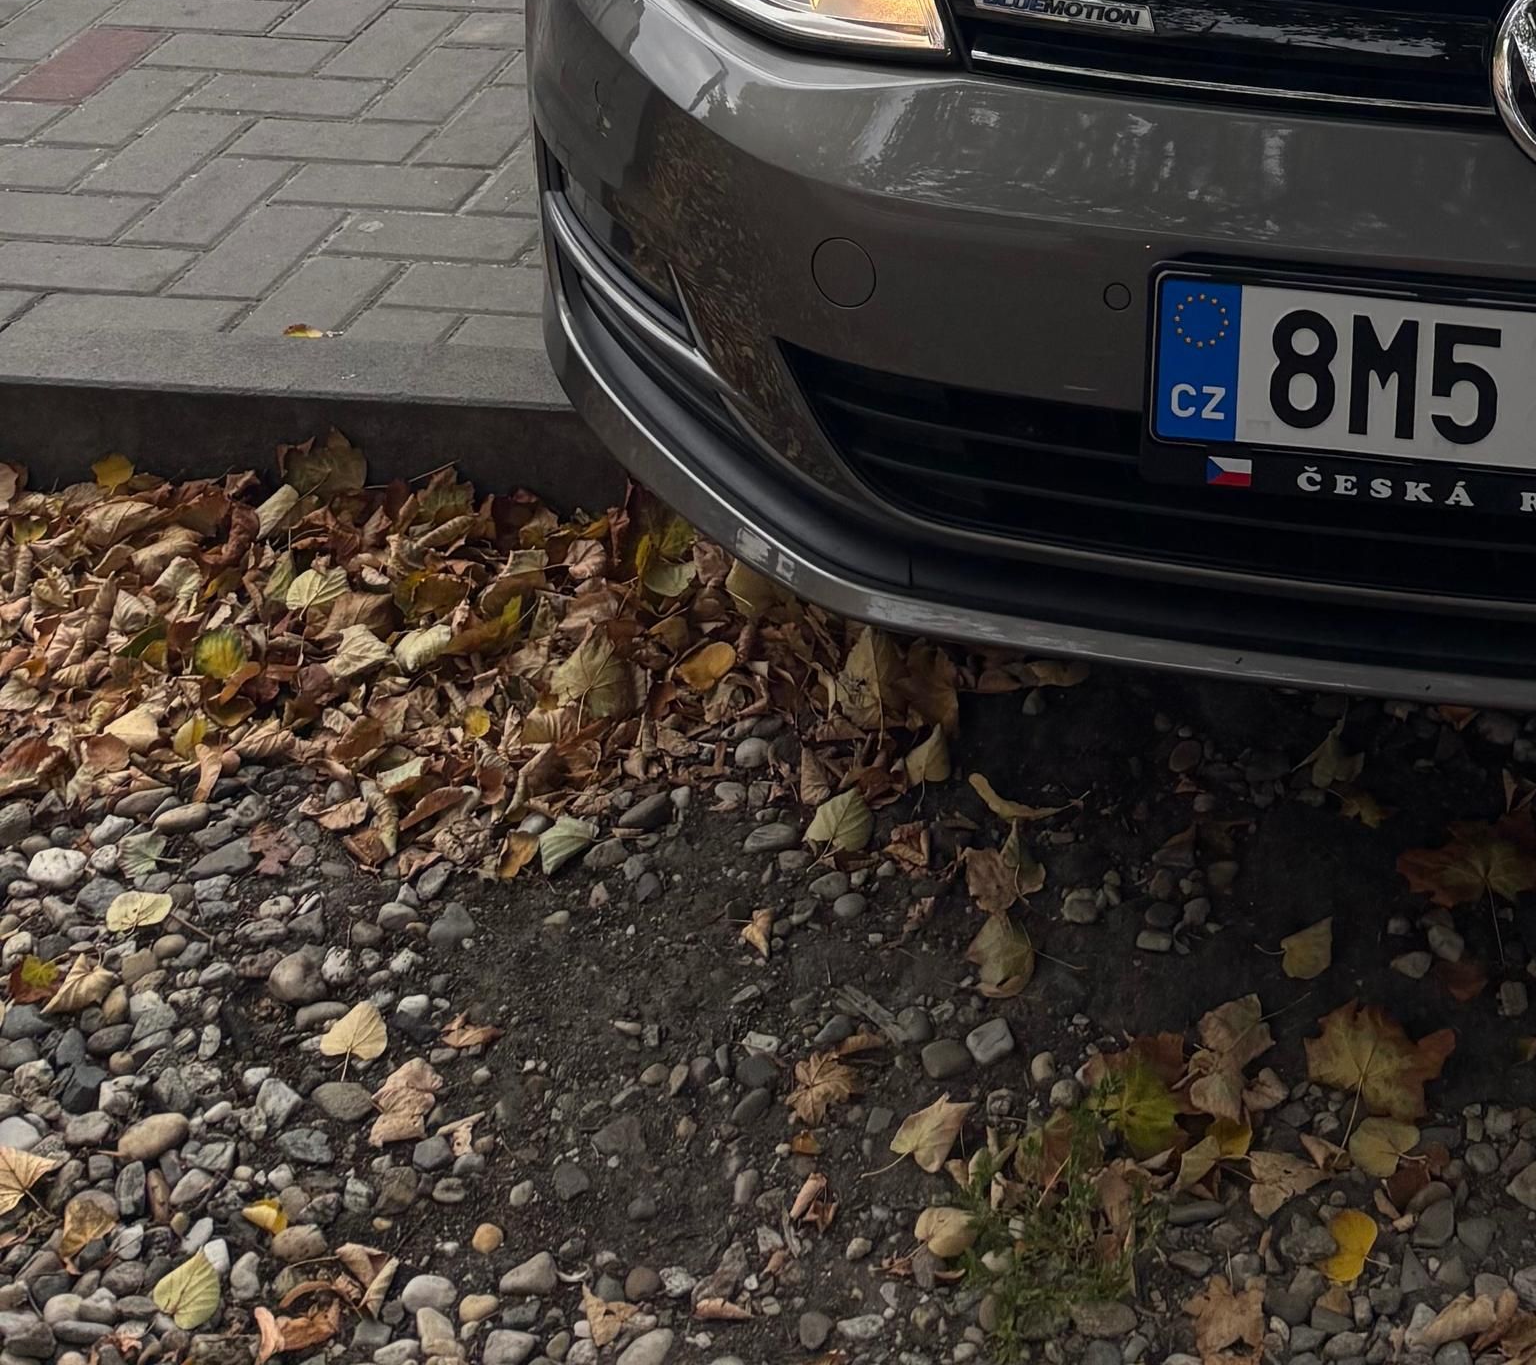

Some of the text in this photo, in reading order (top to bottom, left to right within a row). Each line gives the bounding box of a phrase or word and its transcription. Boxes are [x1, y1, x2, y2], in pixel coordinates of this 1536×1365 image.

[1269, 309, 1503, 446] 8M5
[1170, 381, 1226, 422] CZ
[1296, 465, 1475, 508] ČESKÁ
